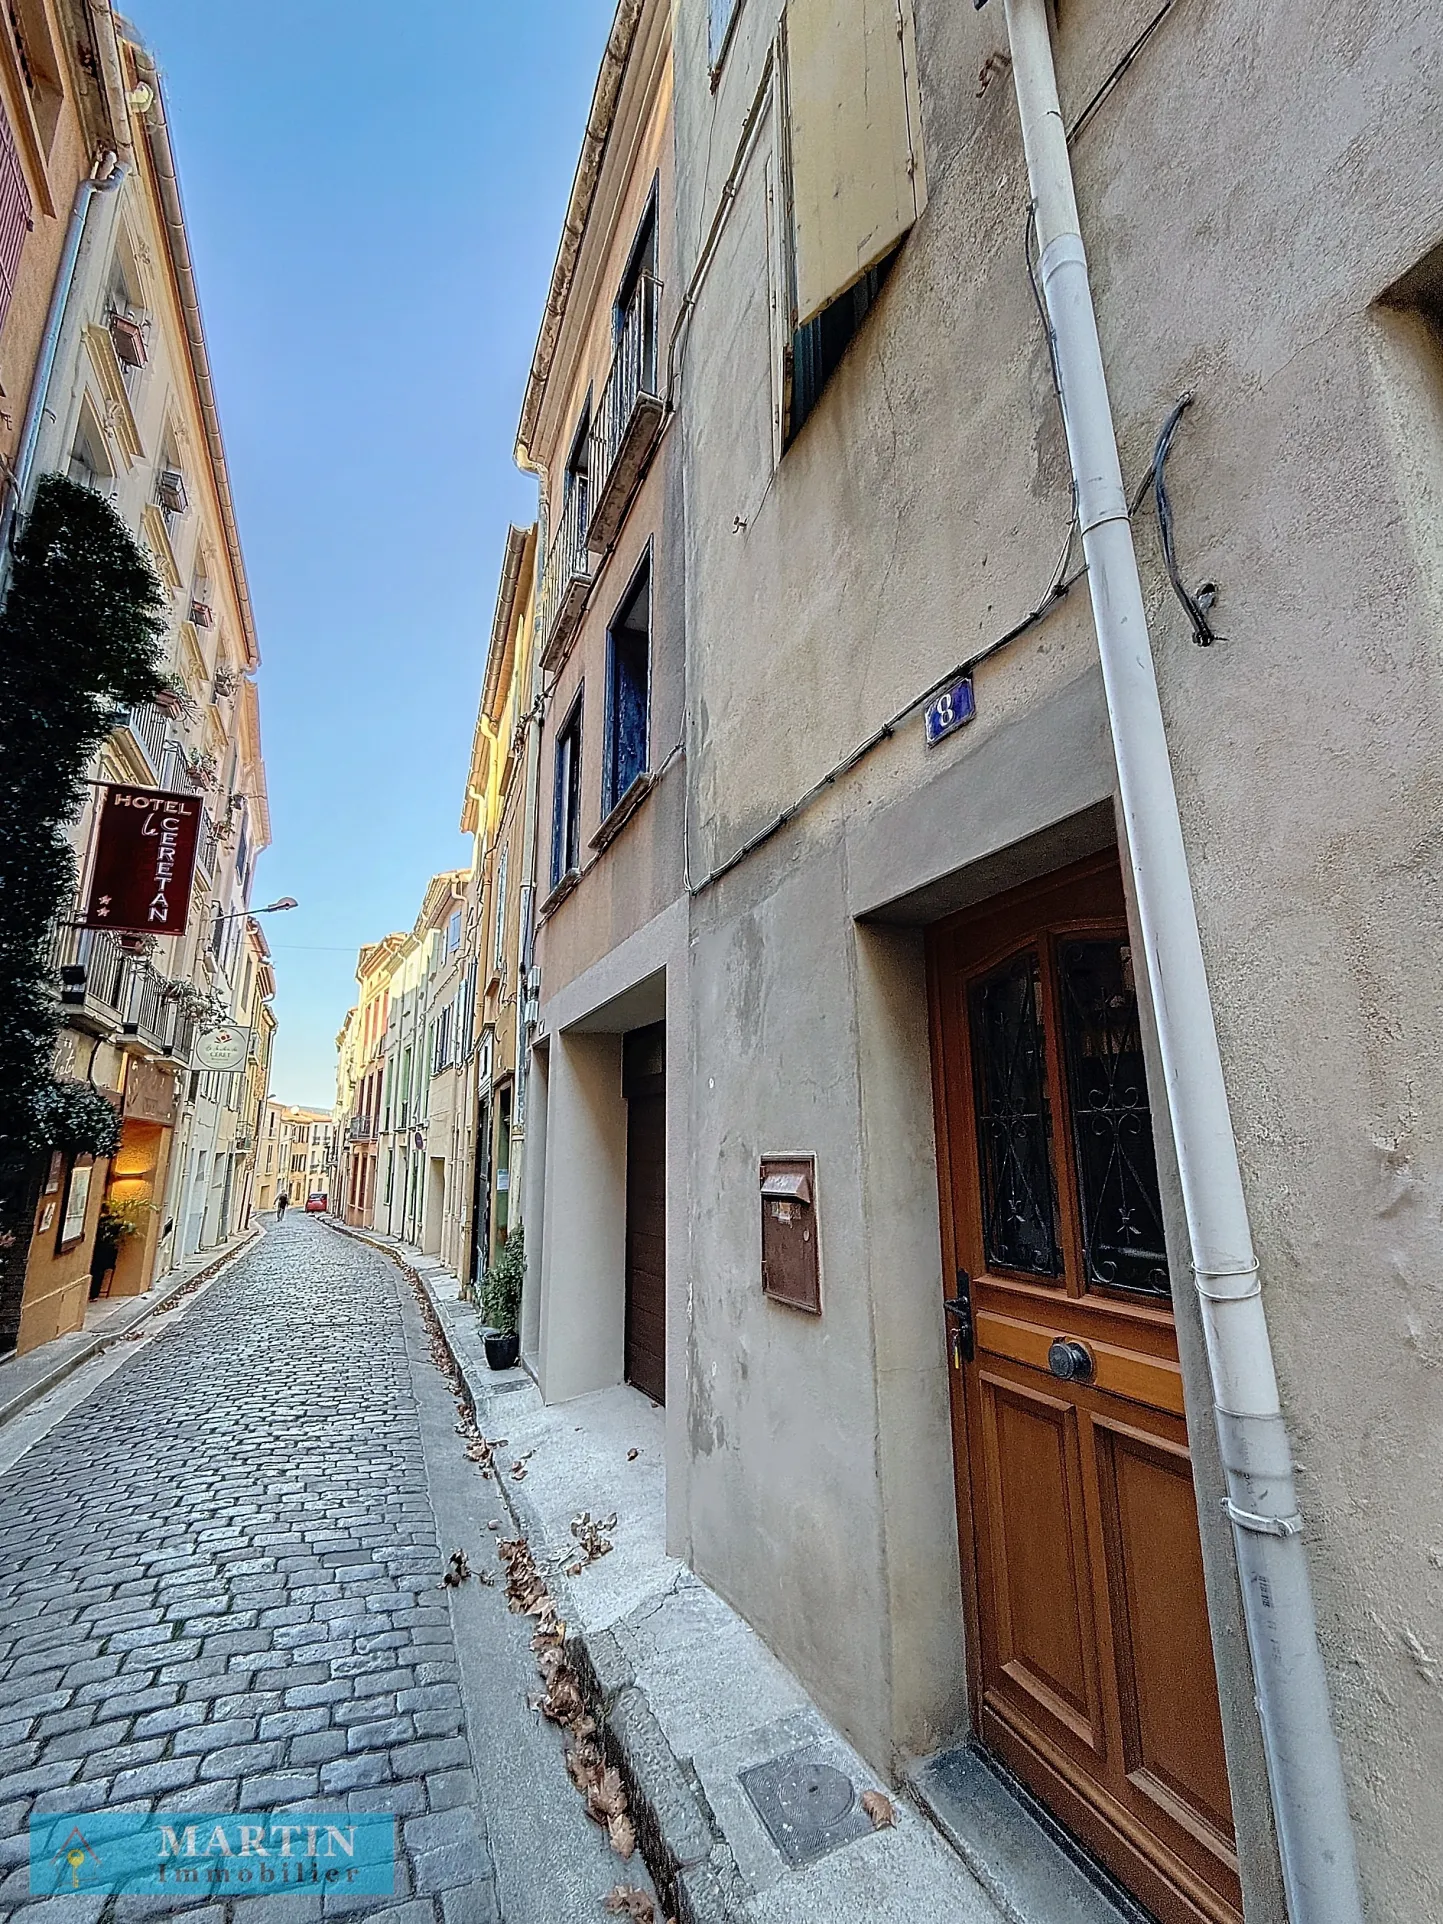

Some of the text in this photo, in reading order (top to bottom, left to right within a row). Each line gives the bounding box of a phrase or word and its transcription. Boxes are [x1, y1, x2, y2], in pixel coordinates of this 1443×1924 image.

[937, 694, 954, 727] 8
[114, 793, 192, 816] HOTEL
[147, 817, 180, 923] CERETAN
